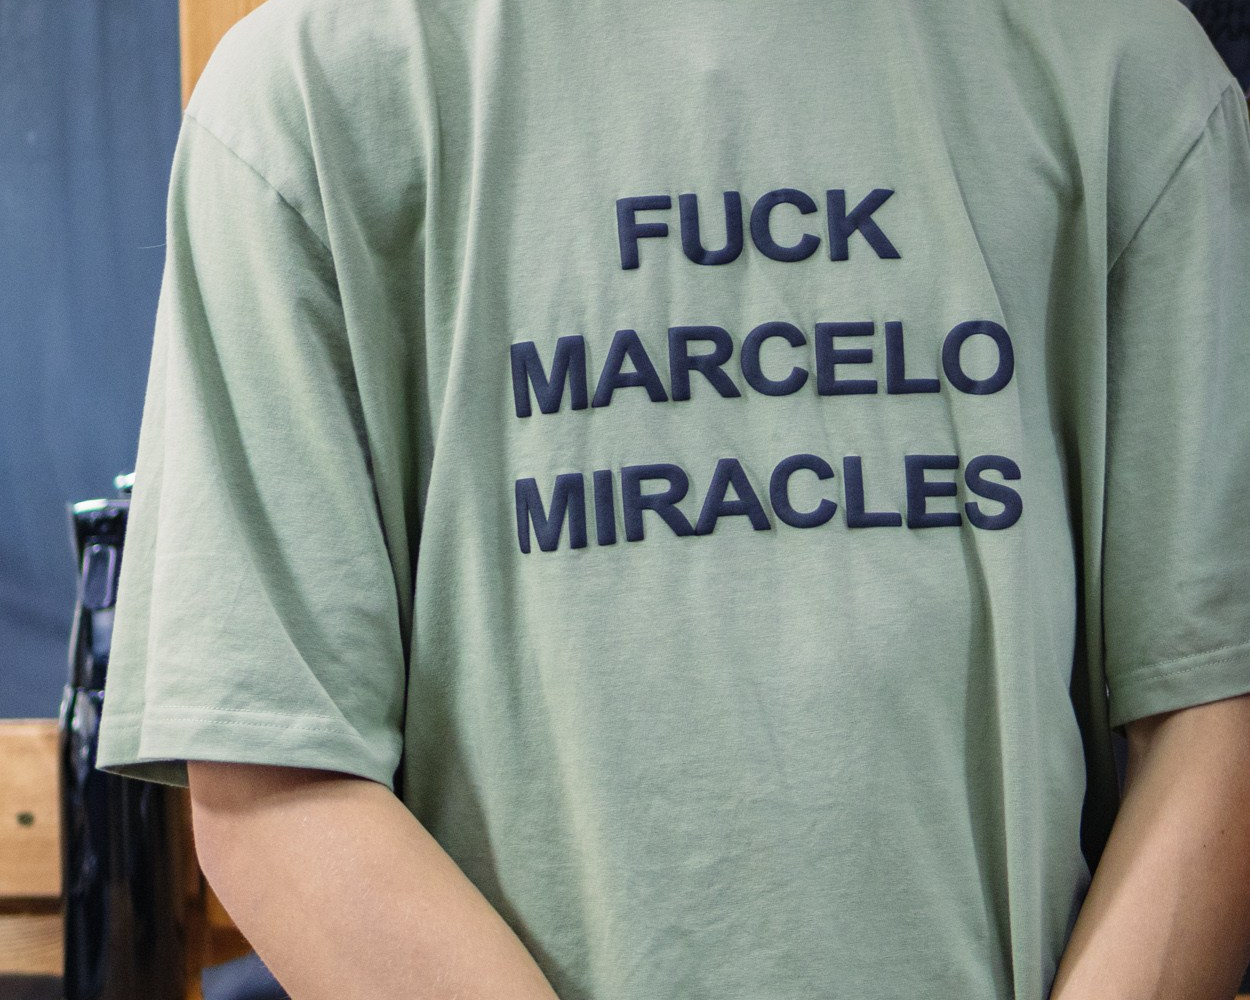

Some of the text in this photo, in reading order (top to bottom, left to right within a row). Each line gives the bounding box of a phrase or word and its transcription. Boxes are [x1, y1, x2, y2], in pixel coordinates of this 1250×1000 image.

[616, 188, 901, 270] FUCK
[510, 320, 1015, 418] MARCELO
[515, 453, 1023, 554] MIRACLES
